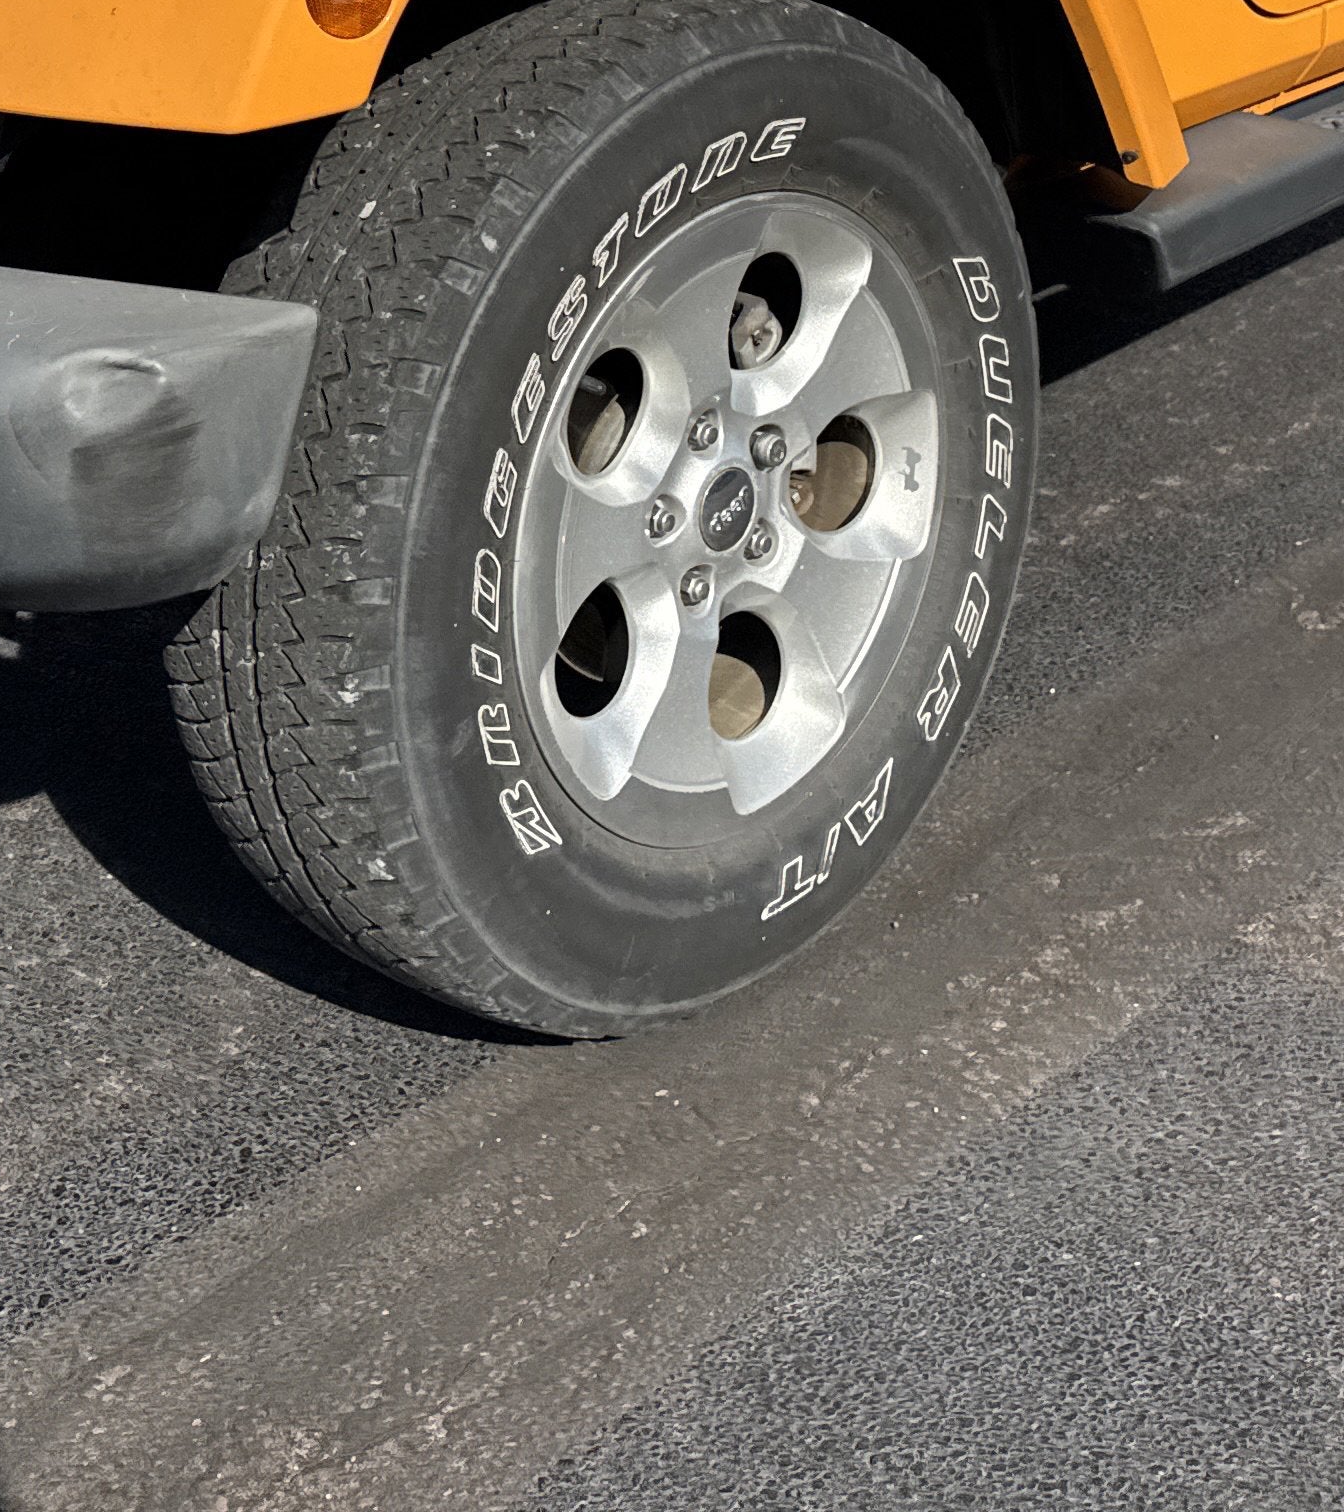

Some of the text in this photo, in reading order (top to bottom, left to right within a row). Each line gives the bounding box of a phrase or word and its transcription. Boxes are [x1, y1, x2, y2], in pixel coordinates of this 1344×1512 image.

[471, 117, 806, 855] BRIDGESTONE
[761, 256, 1013, 920] DUELER A/T
